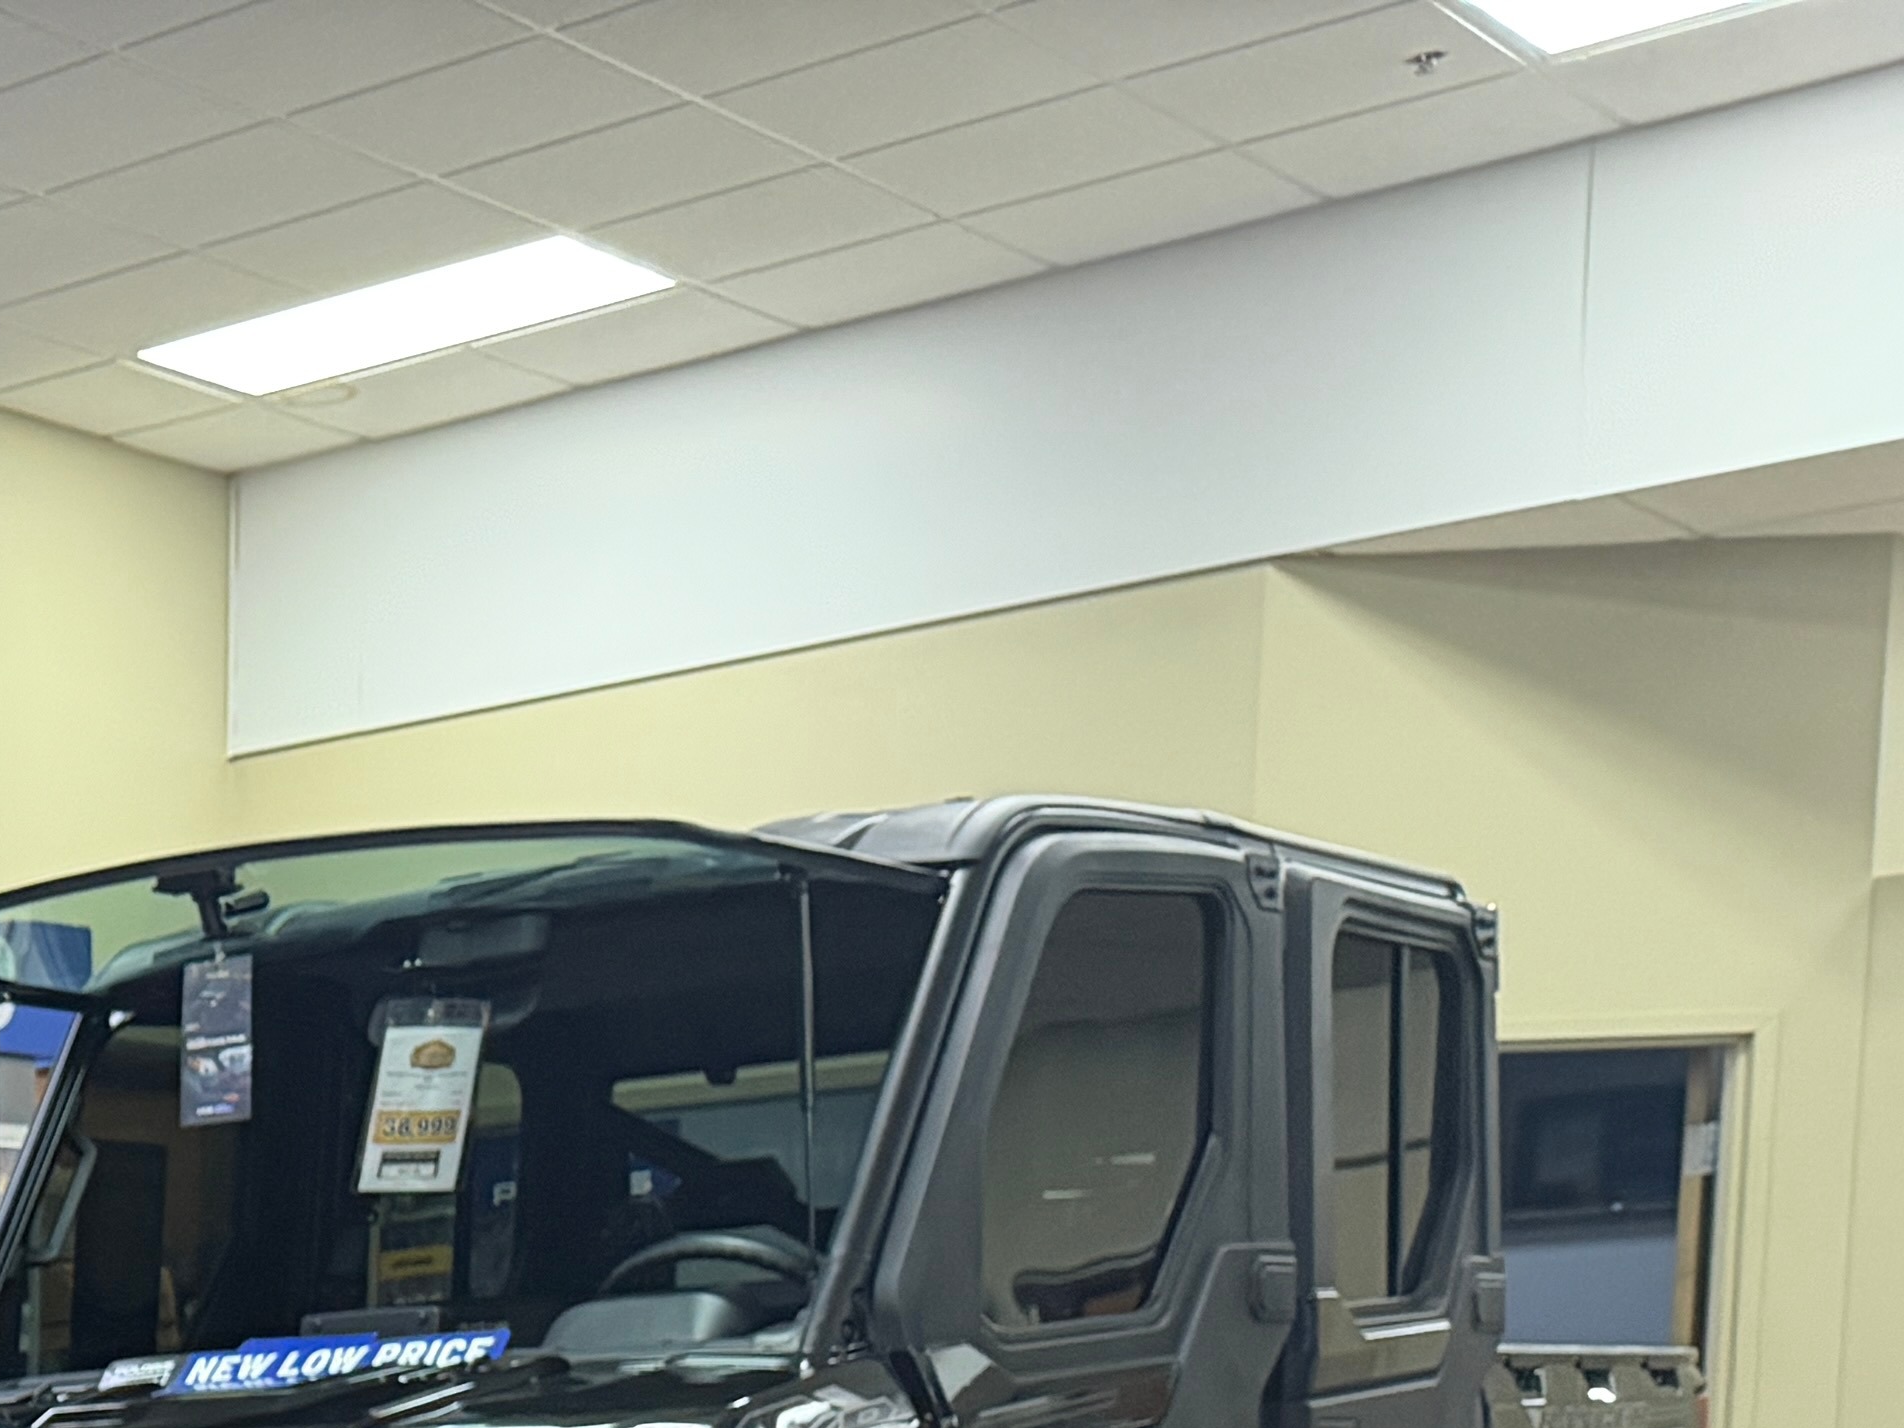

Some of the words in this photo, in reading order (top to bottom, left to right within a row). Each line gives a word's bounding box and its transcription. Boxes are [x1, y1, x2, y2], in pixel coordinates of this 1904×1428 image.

[185, 1351, 278, 1386] NEW
[277, 1344, 369, 1378] LOW
[371, 1336, 494, 1368] PRICE
